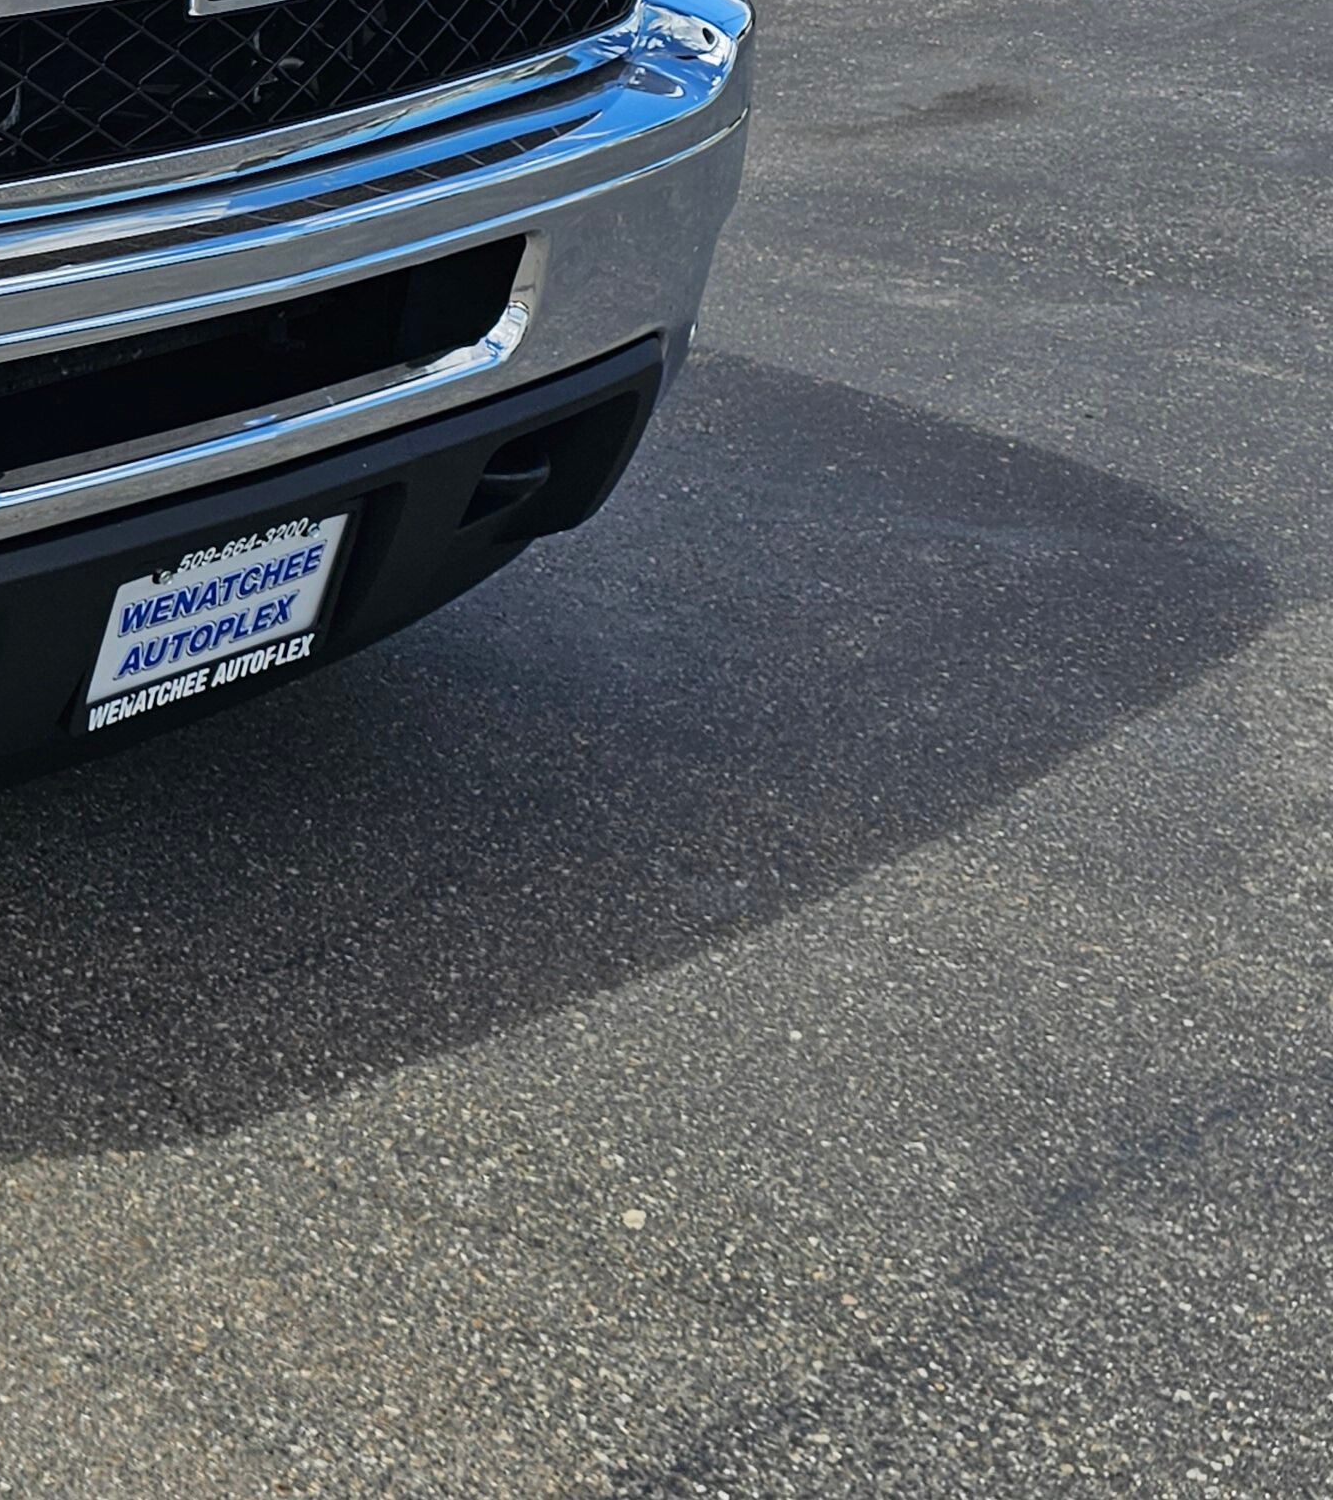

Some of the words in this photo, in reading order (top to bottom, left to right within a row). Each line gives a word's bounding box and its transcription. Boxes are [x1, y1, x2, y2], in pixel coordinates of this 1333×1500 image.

[177, 517, 310, 573] 509-664-3200
[118, 539, 327, 638] WENATCHEE
[113, 589, 300, 681] AUTOPLEX
[88, 667, 211, 732] WENATCHEE
